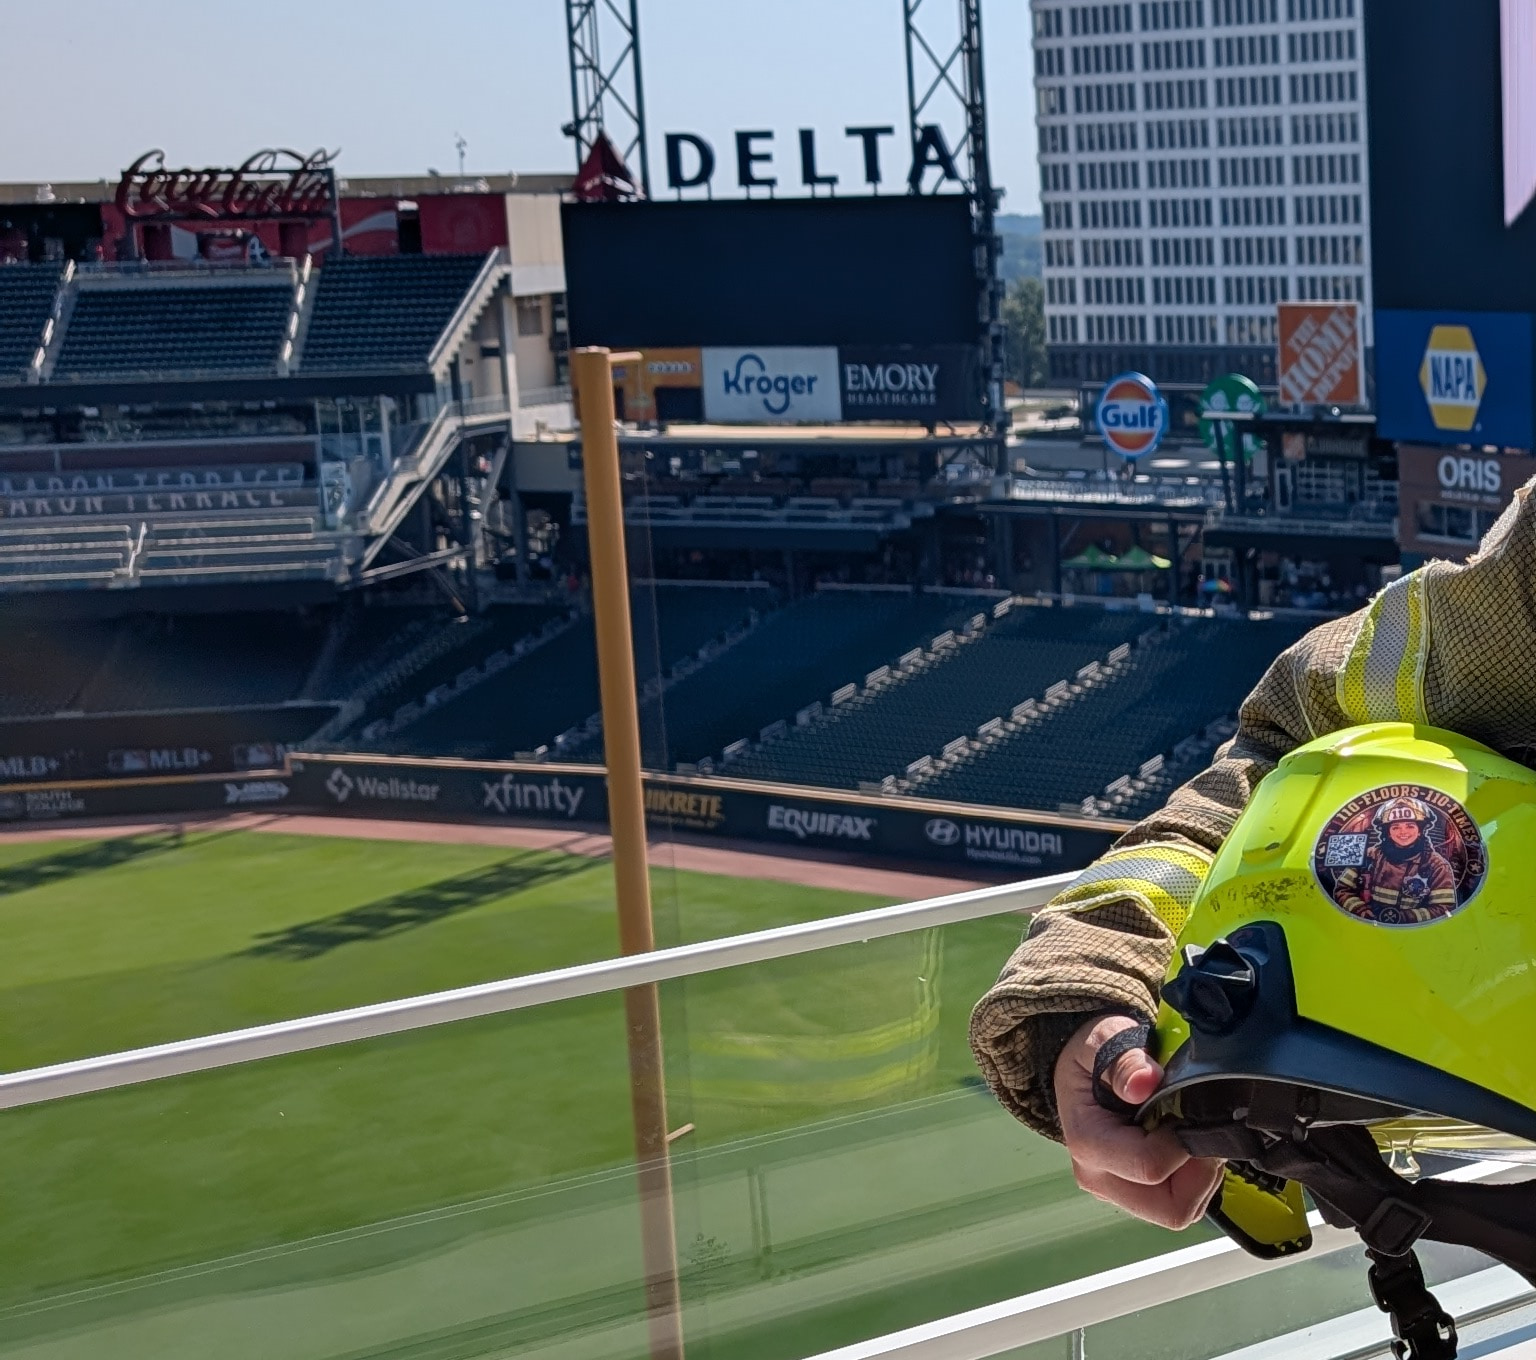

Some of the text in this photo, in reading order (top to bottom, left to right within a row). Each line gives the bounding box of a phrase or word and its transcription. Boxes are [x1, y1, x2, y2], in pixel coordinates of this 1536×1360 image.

[664, 124, 960, 189] DELTA
[1280, 306, 1357, 403] HOME
[723, 354, 818, 415] Kroger
[845, 363, 939, 392] EMORY
[1431, 355, 1476, 401] NAPA
[847, 393, 937, 406] HEALTHCARE
[1101, 404, 1159, 428] Gulf
[1438, 455, 1501, 492] ORIS
[356, 776, 440, 801] Wellstar
[482, 773, 584, 817] xfinity
[768, 804, 872, 840] EQUIFAX
[1391, 808, 1412, 818] 110
[965, 824, 1062, 855] HYUNDAI
